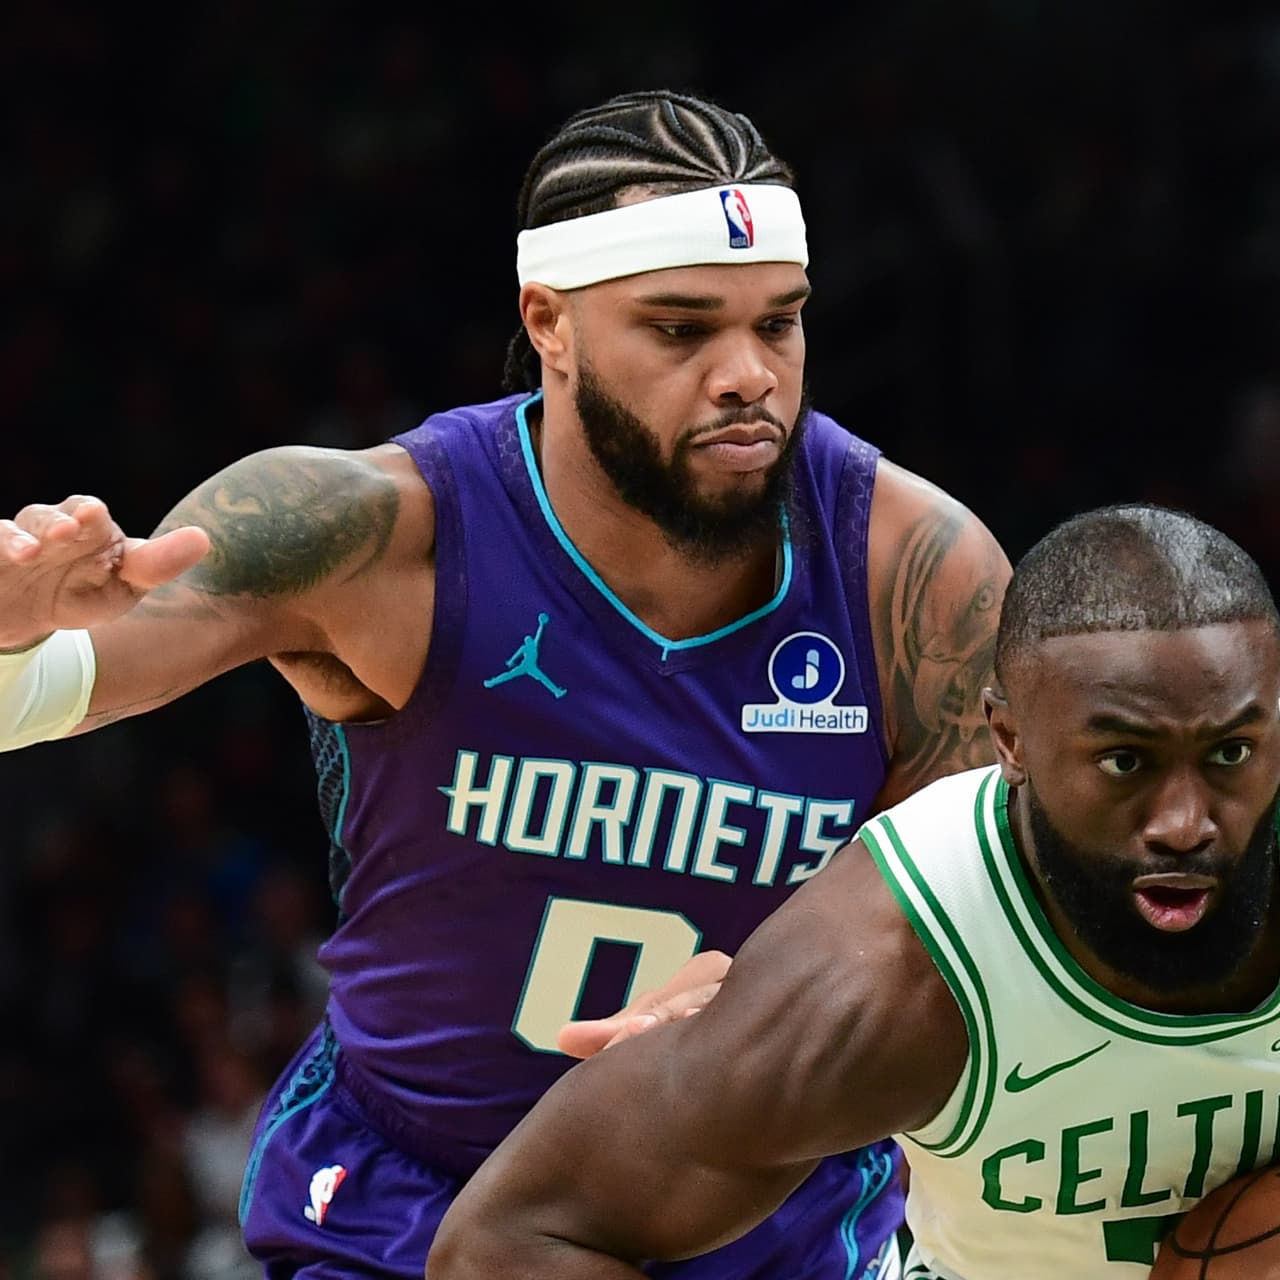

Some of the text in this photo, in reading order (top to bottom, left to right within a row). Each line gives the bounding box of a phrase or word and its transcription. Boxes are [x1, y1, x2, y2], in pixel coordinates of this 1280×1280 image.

[746, 708, 865, 730] Judi Health
[437, 749, 855, 887] HORNETS
